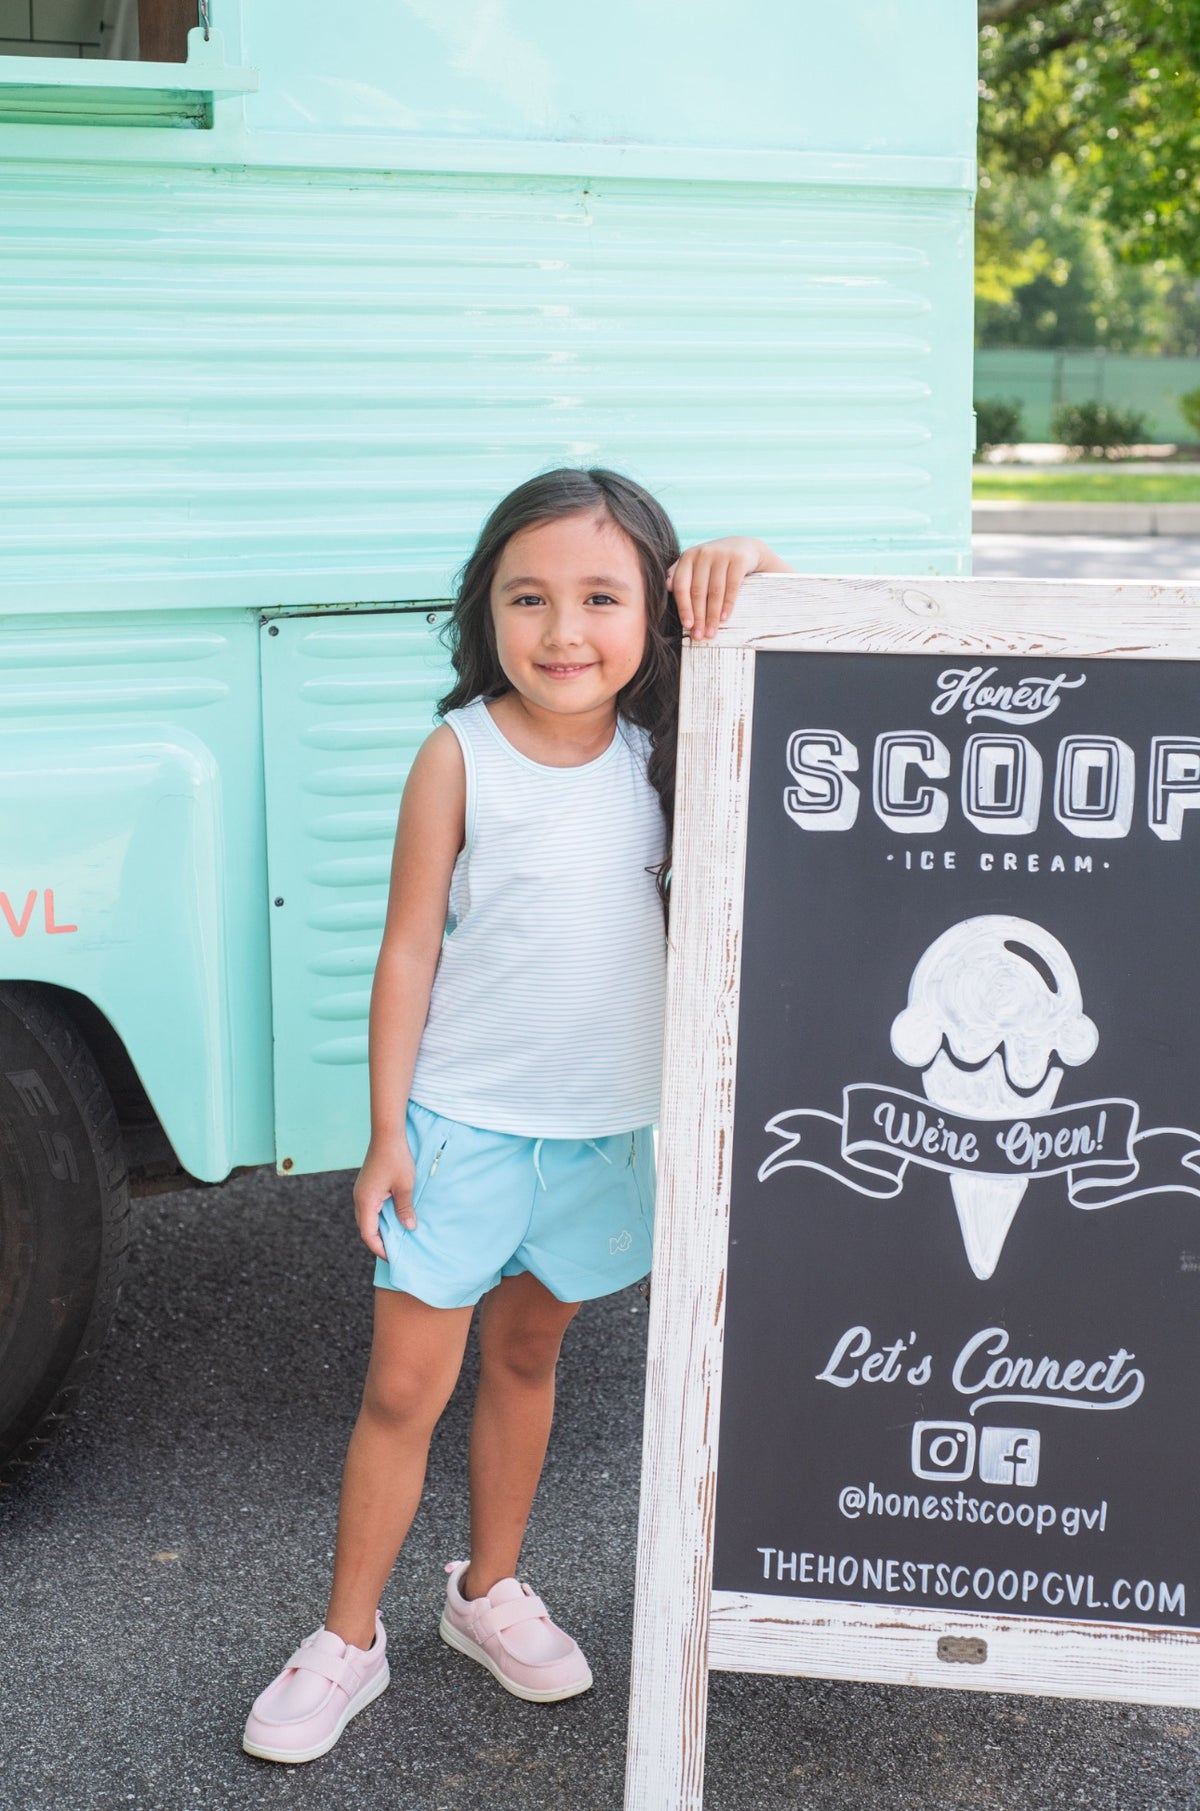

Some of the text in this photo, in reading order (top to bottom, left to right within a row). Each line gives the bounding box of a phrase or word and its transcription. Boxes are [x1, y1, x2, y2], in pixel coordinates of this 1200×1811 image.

[930, 666, 1087, 725] Honest
[783, 729, 1200, 841] SCOOP
[905, 850, 1093, 874] ICE CREAM
[873, 1101, 1107, 1170] We're Open!
[815, 1325, 1146, 1417] Let's Connect
[757, 1547, 1187, 1617] THEHONESTSCOOPGVL.COM
